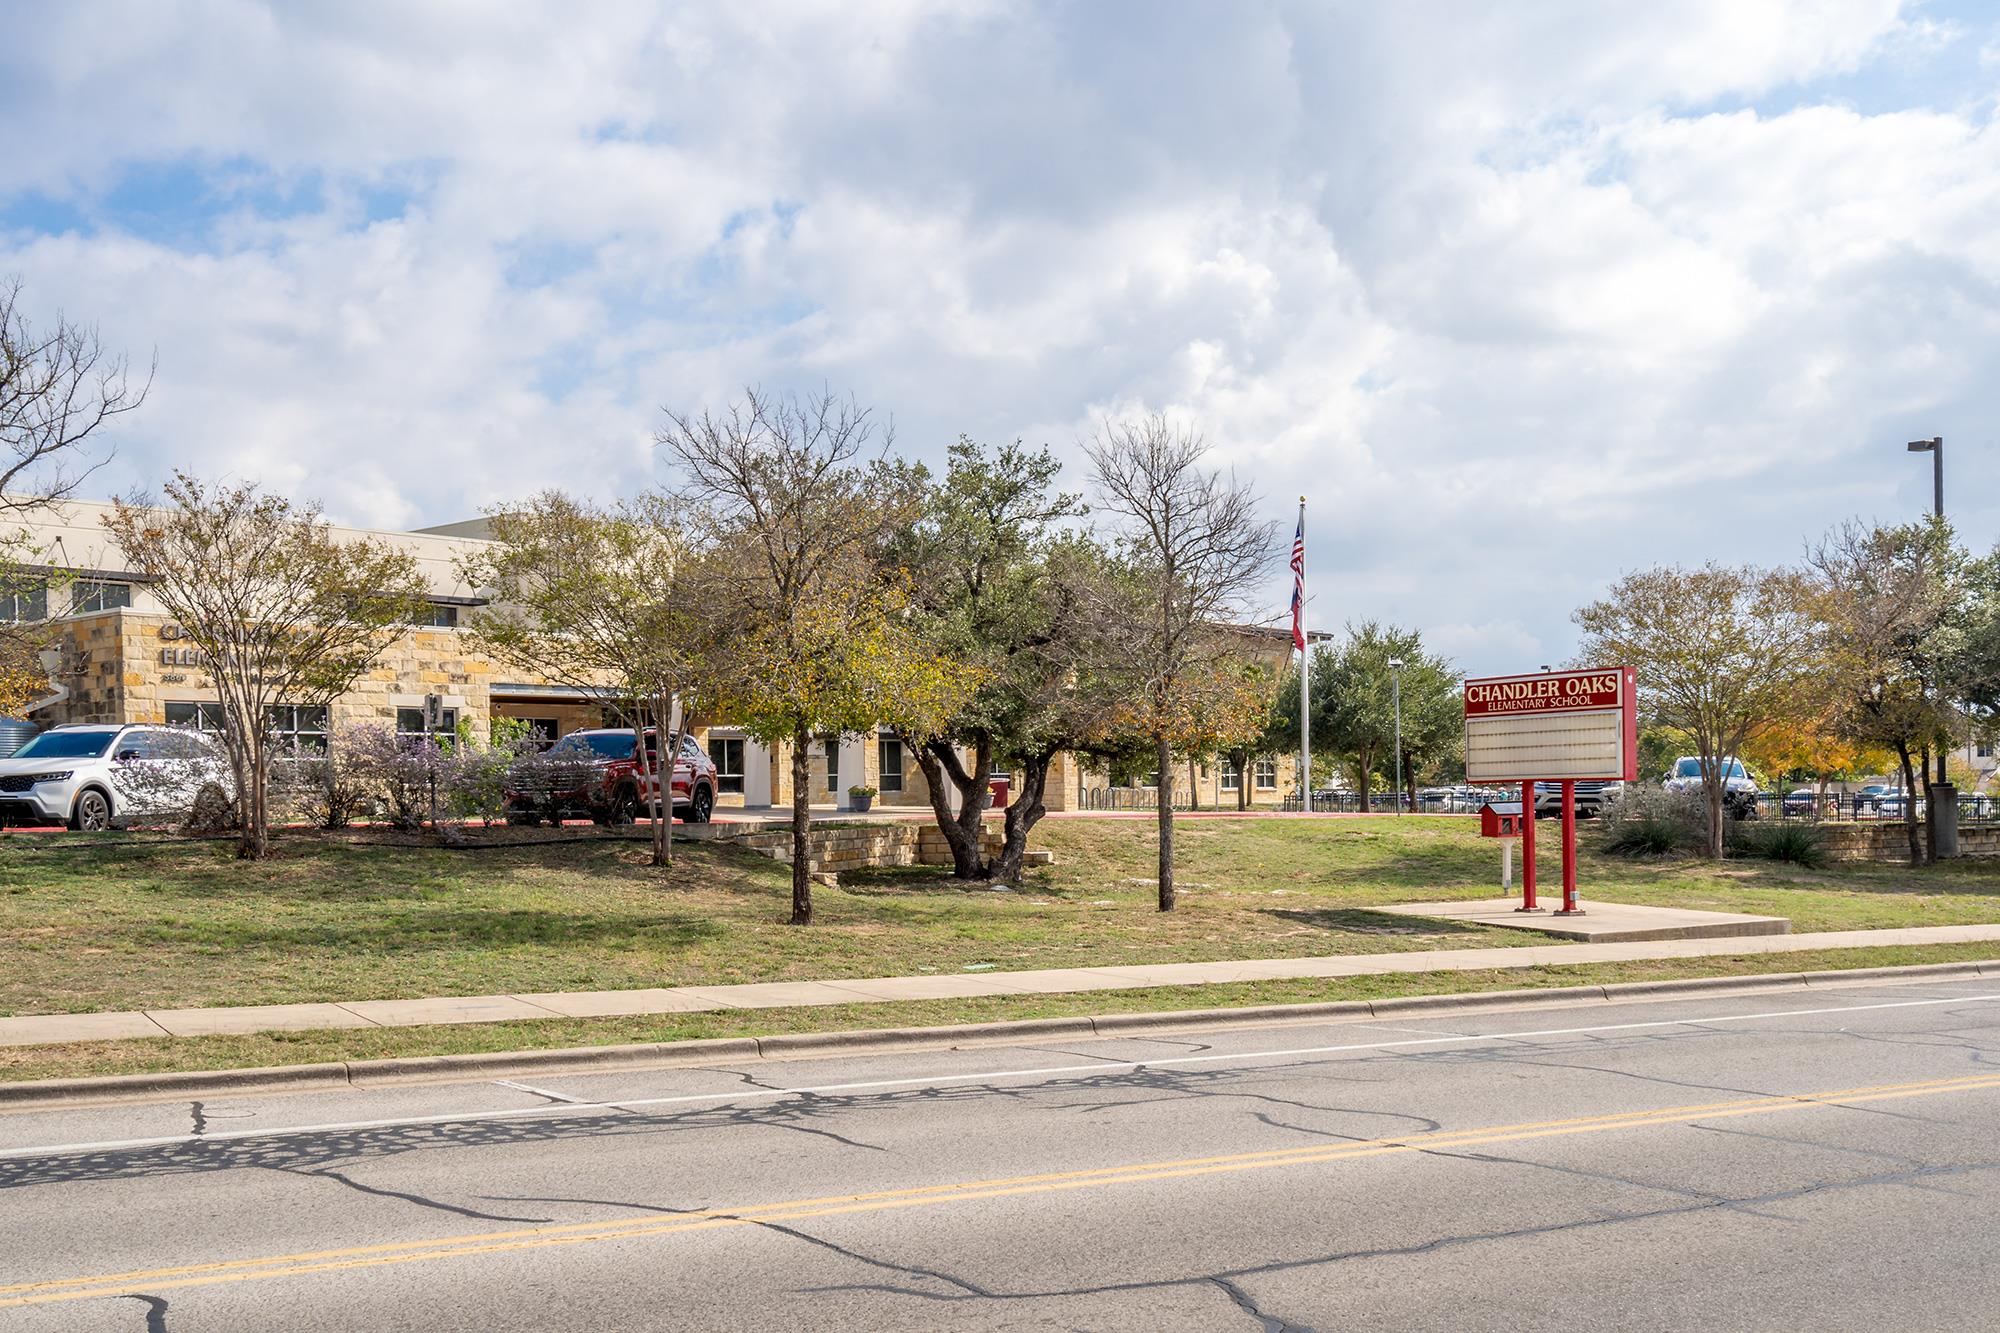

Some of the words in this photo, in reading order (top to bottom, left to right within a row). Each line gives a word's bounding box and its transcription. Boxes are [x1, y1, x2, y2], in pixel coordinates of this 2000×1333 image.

[1467, 679, 1560, 703] CHANDLER
[1565, 675, 1617, 696] OAKS
[1488, 698, 1547, 712] ELEMENTARY
[1550, 695, 1593, 707] SCHOOL
